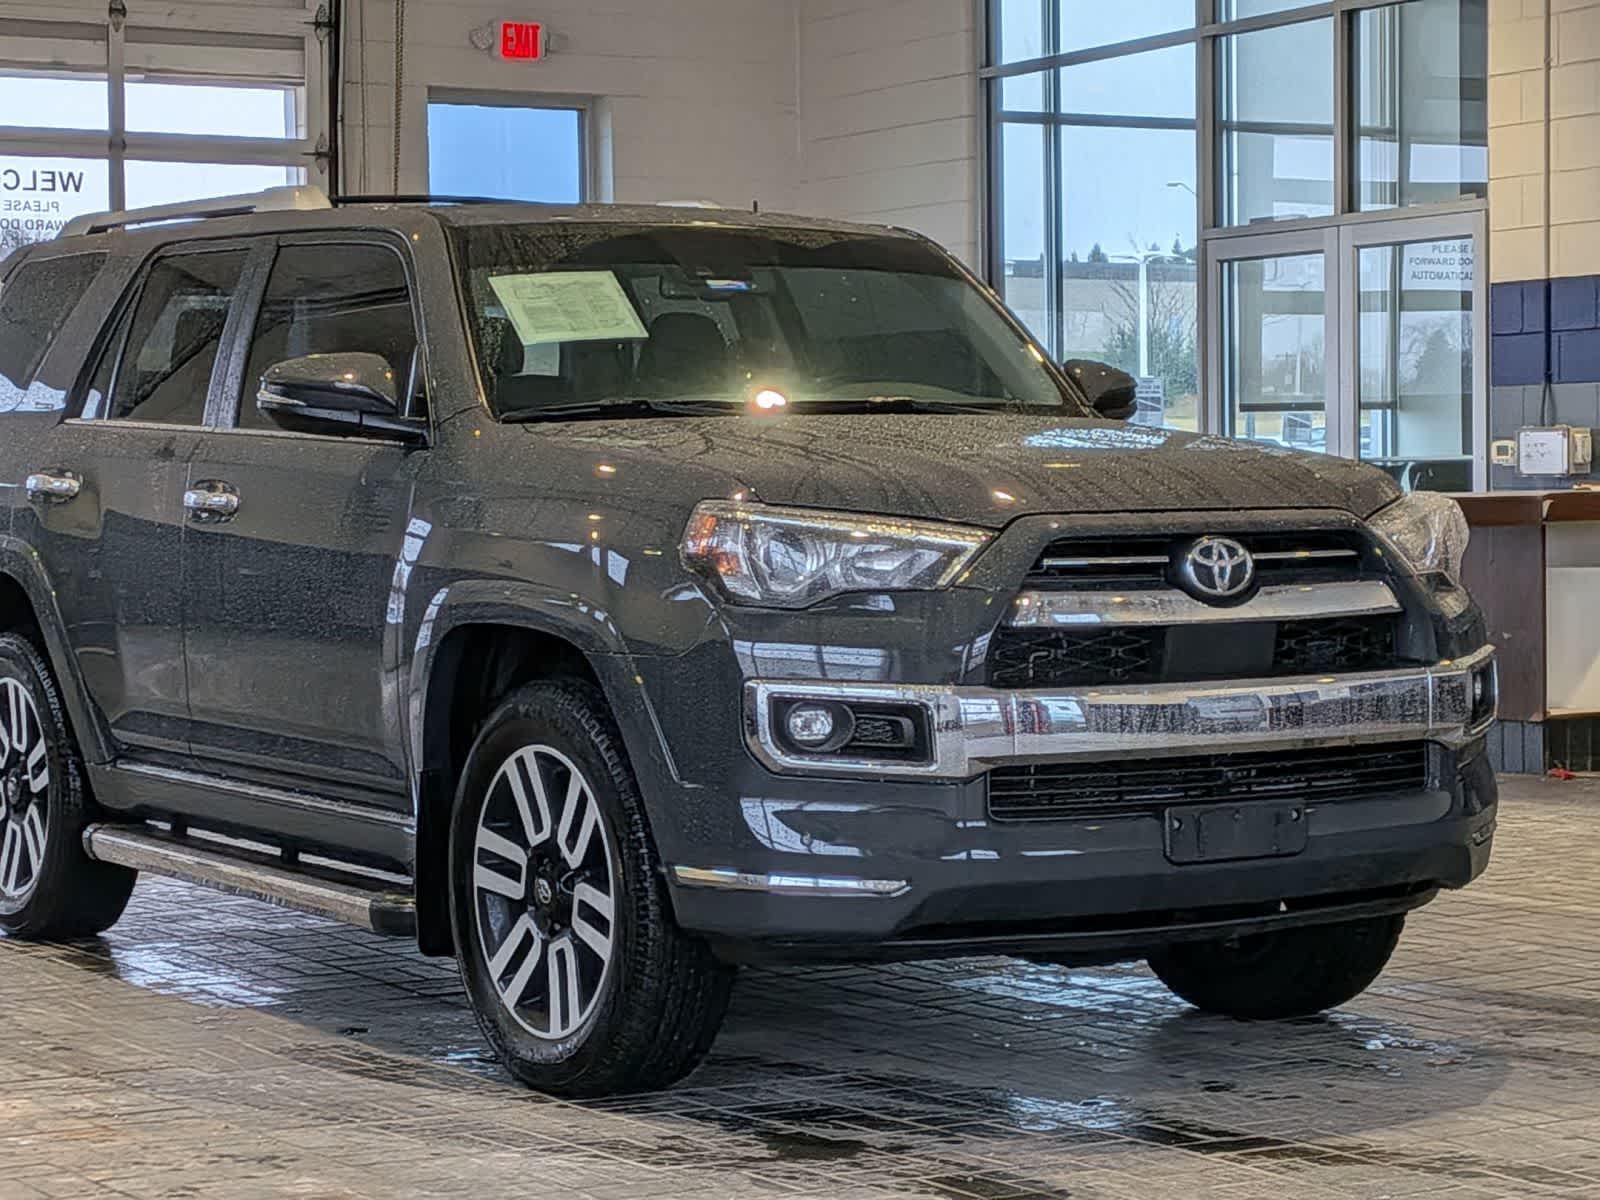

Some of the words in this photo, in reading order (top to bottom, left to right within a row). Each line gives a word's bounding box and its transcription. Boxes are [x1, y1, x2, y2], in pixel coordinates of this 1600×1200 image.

[502, 23, 540, 58] EXIT
[1432, 244, 1469, 253] PLEASE
[1409, 257, 1455, 265] FORWARD
